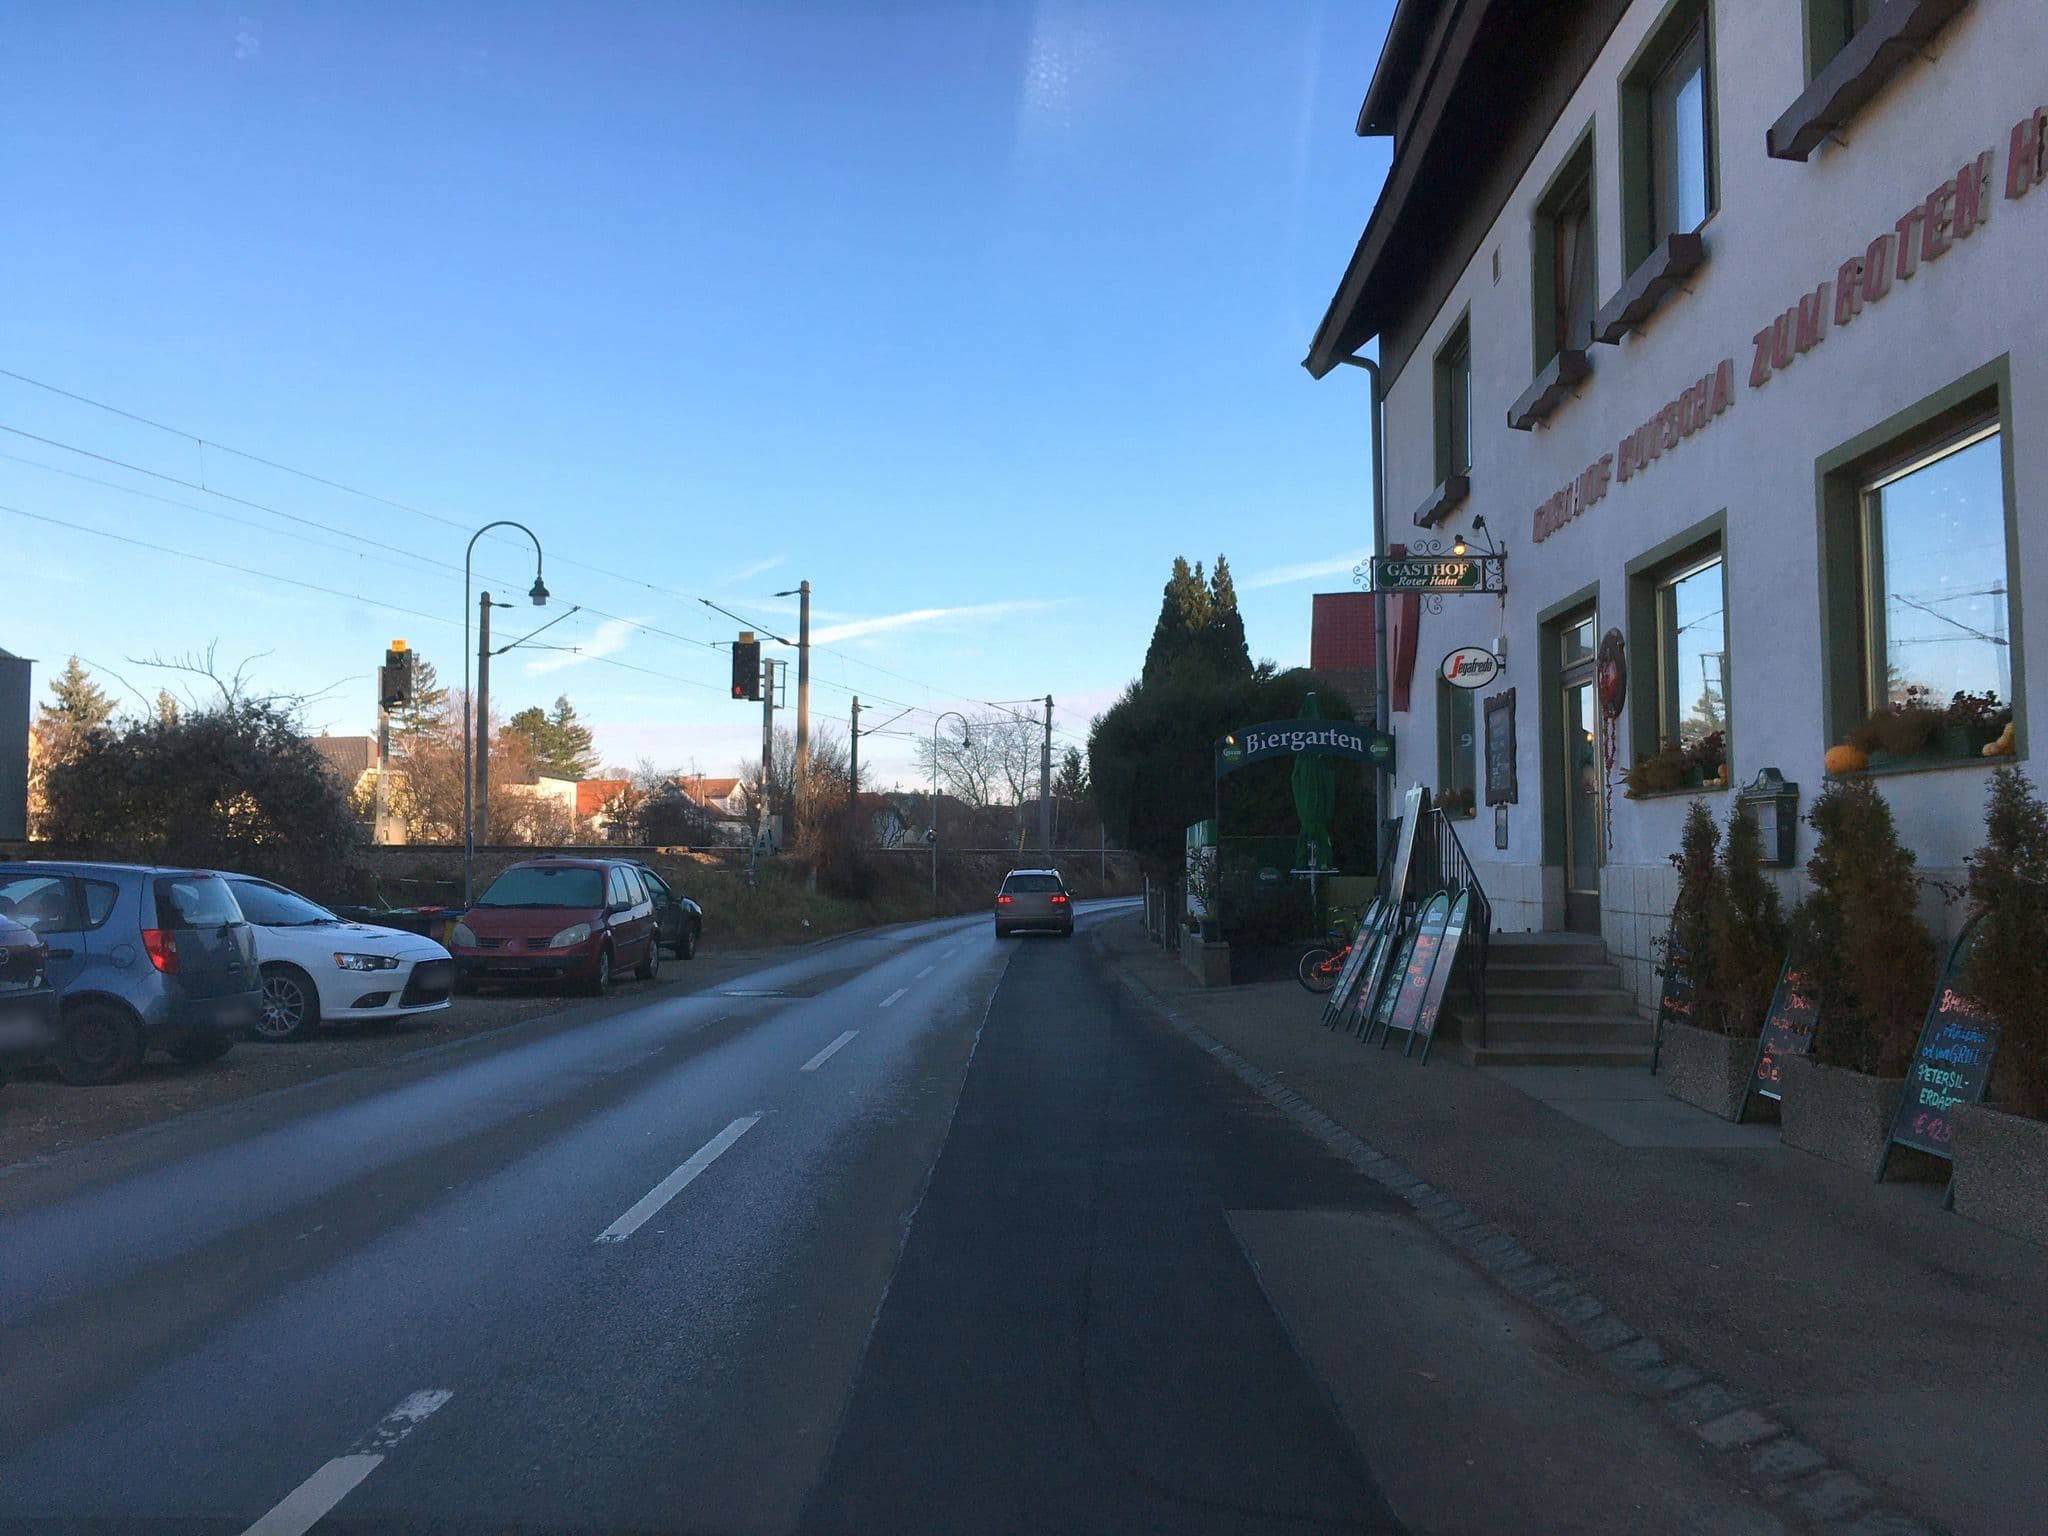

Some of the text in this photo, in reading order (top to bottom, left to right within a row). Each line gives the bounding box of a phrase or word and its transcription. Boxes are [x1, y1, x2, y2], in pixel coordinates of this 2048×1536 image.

[1748, 281, 1832, 388] ZUM
[1834, 149, 1995, 326] ROTEN
[1386, 563, 1470, 577] GASTHOF
[1447, 655, 1494, 679] Segafredo
[1246, 728, 1364, 755] Biergarten
